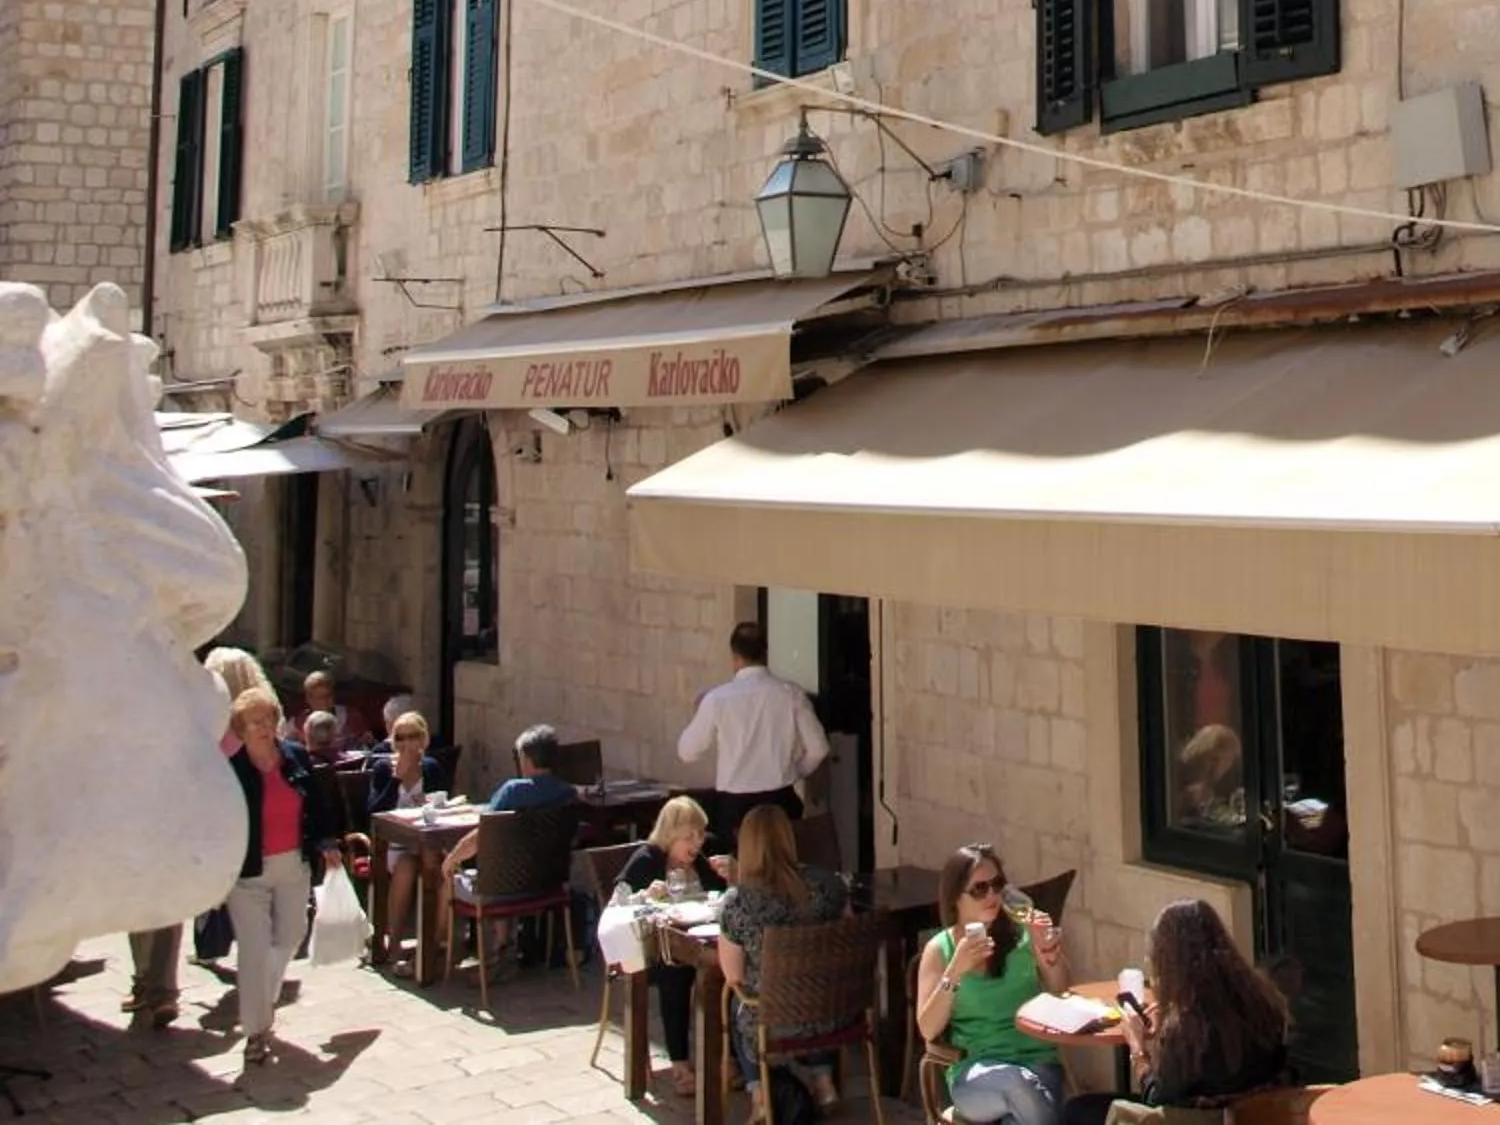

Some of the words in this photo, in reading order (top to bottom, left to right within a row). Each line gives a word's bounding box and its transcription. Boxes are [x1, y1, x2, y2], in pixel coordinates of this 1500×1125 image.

[422, 364, 493, 402] Karlovačko
[522, 359, 613, 397] PENATUR
[647, 349, 741, 397] Karlovačko
